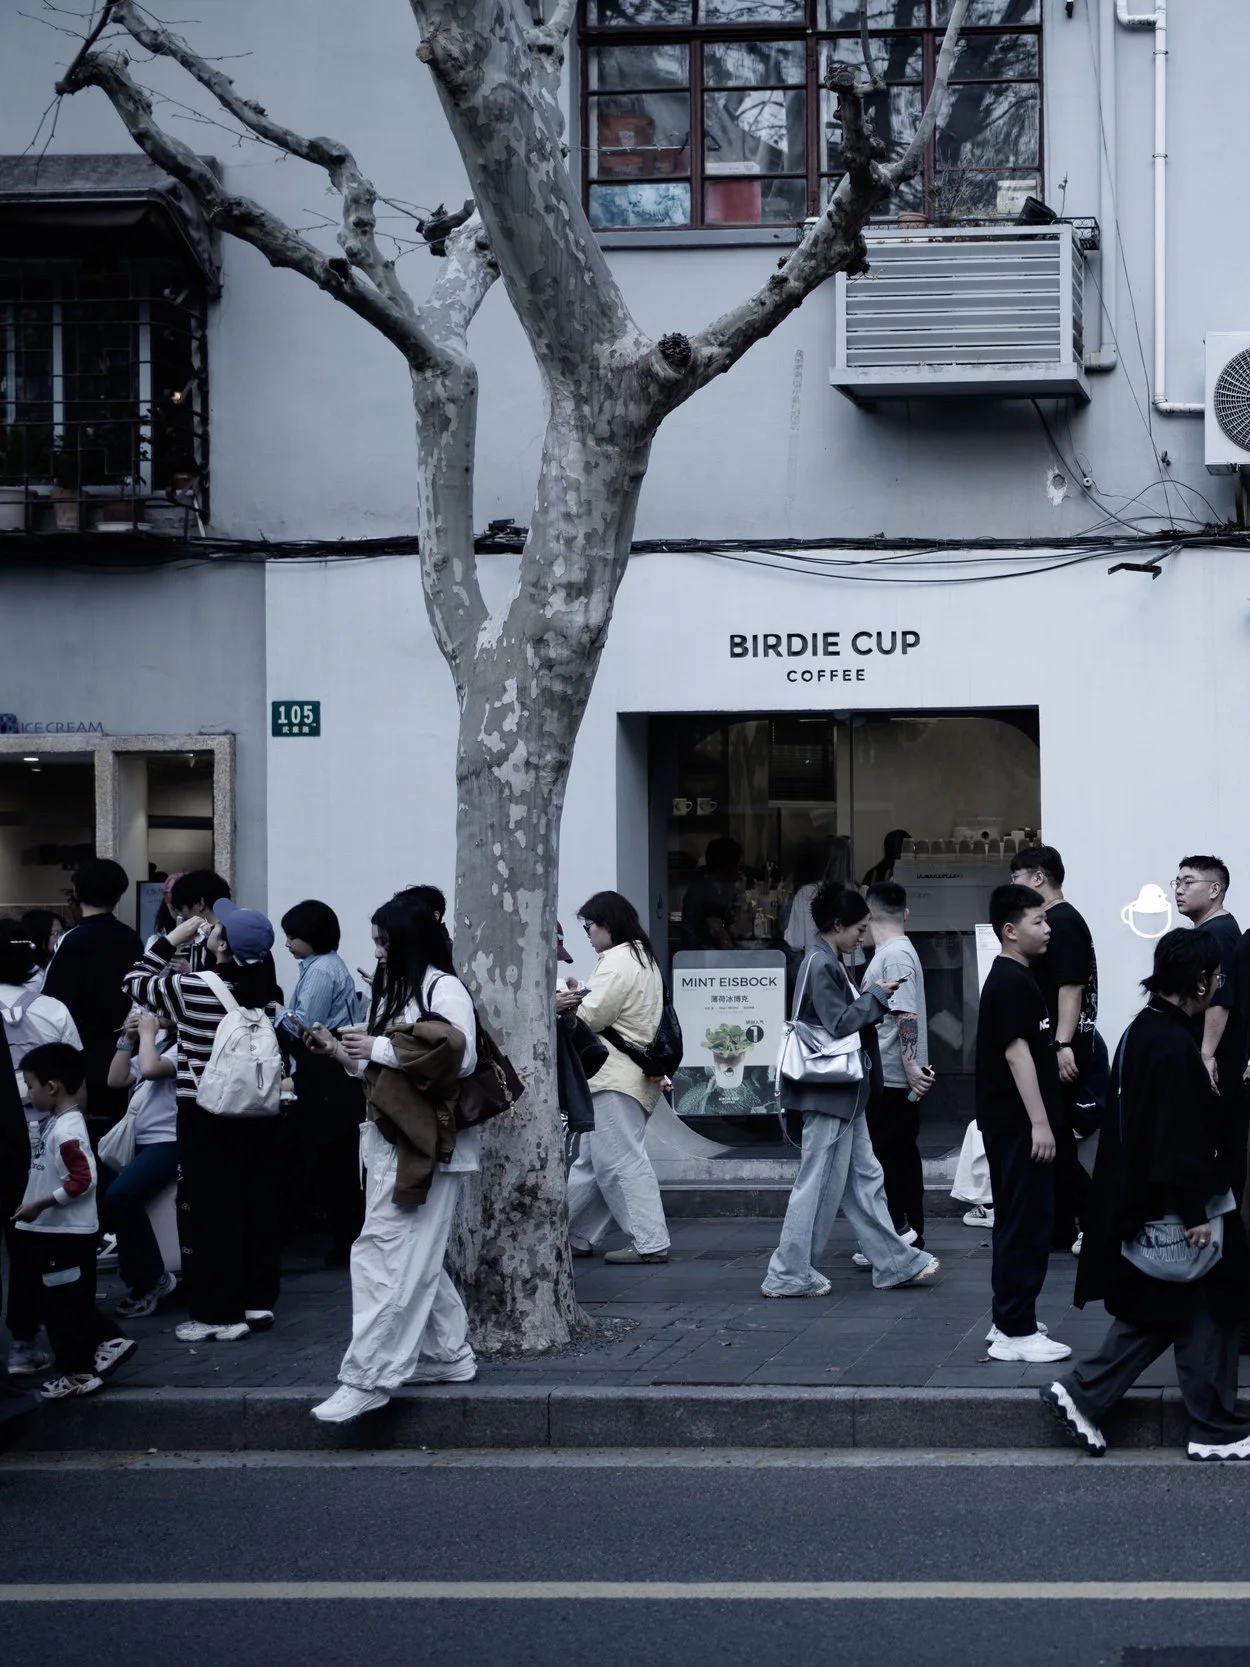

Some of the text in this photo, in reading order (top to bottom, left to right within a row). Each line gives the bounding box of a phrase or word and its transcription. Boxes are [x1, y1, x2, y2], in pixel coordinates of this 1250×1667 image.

[729, 630, 921, 658] BIRDIE CUP
[786, 669, 866, 683] COFFEE
[278, 705, 314, 724] 105
[21, 722, 44, 733] ICE
[46, 721, 104, 733] CREAM
[681, 976, 778, 988] MINT EISBOCK
[710, 995, 749, 1003] 薄荷冰博克
